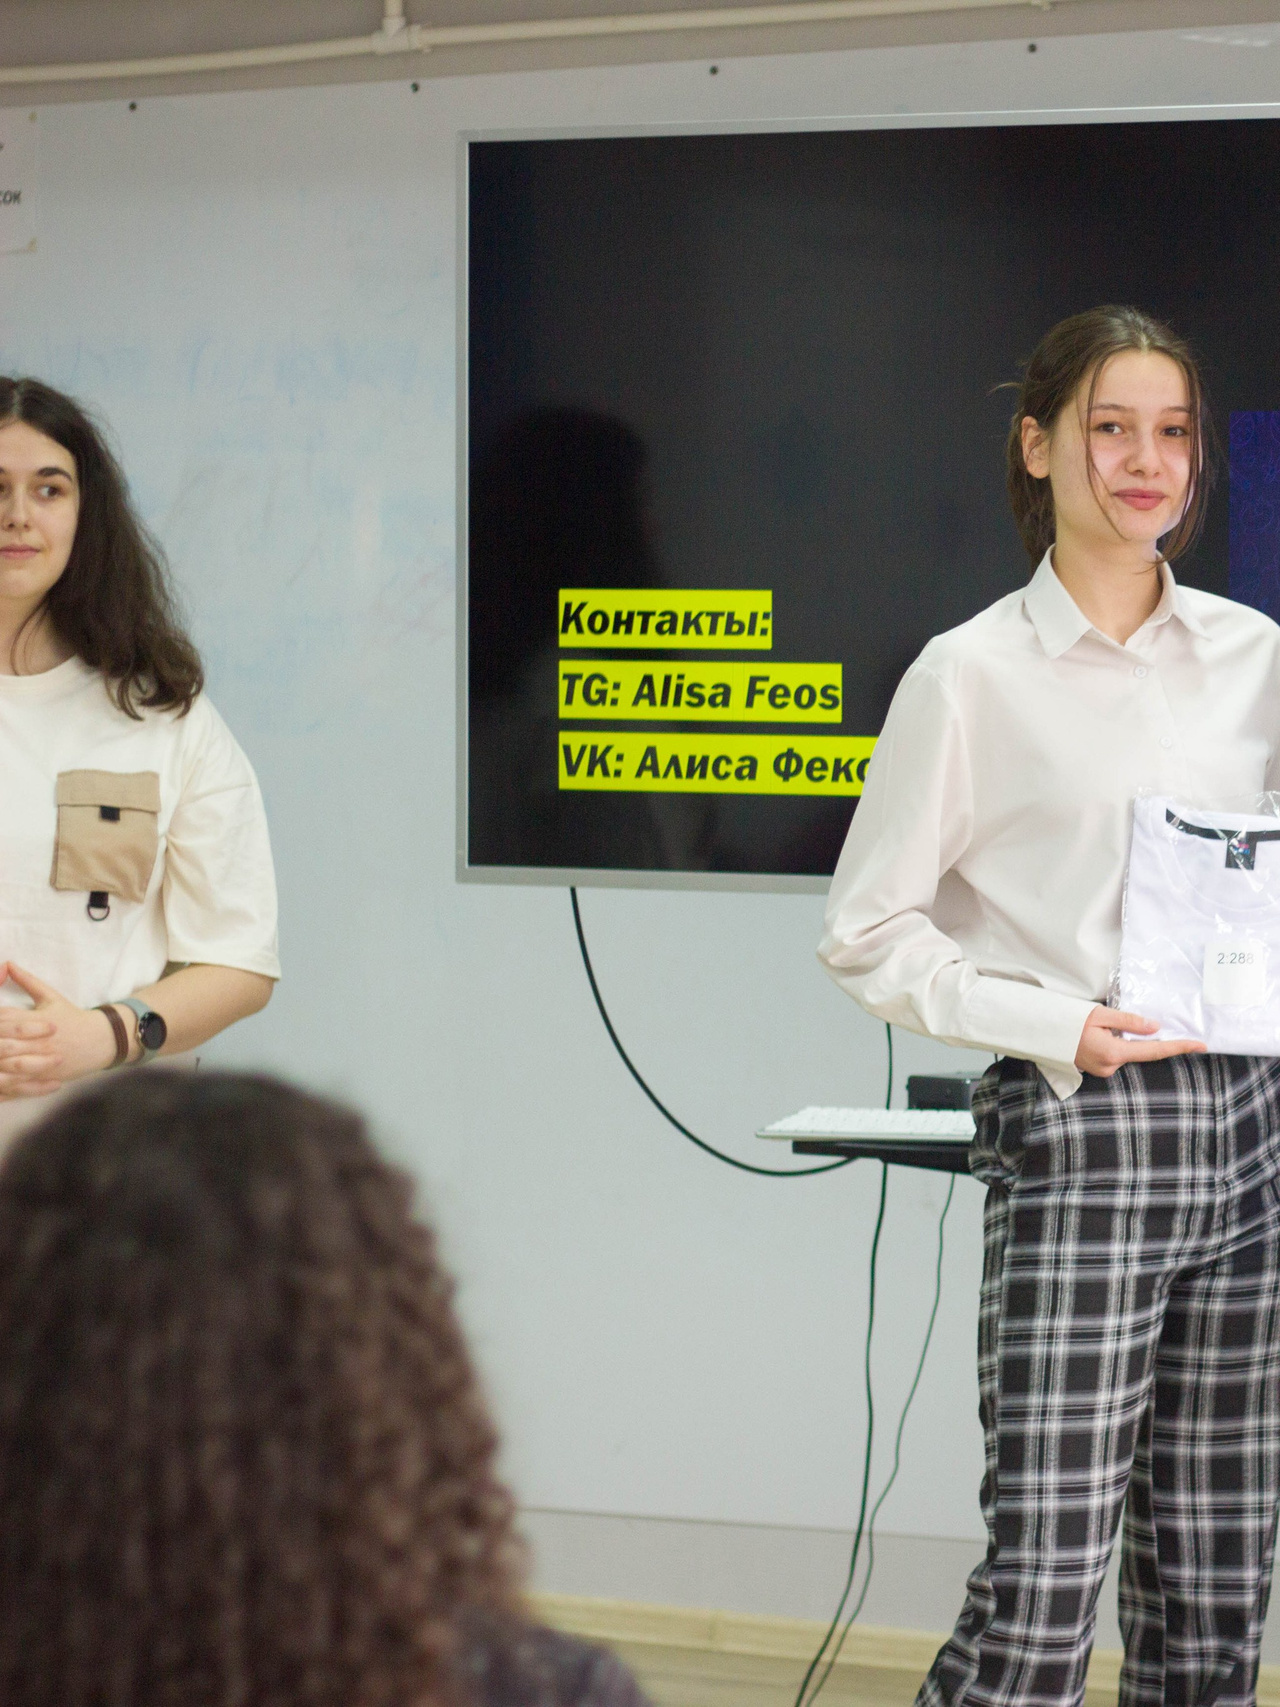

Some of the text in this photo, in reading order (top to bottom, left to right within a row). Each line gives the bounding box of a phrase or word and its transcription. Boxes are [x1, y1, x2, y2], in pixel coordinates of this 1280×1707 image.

[560, 602, 771, 637] Контакты:
[562, 673, 841, 711] TG: Alisa Feos
[562, 743, 624, 779] VK:
[634, 745, 759, 781] Алиса
